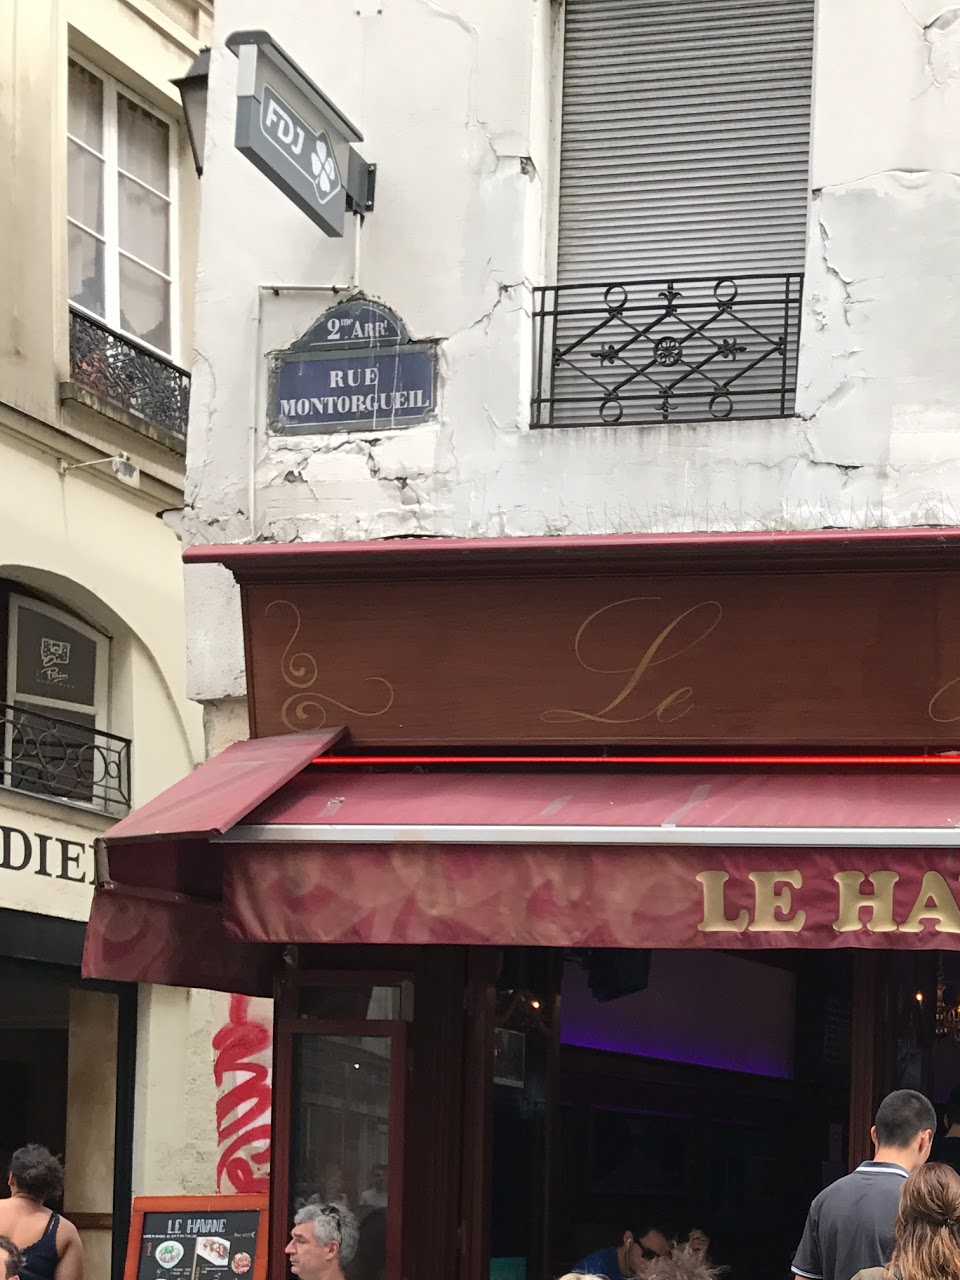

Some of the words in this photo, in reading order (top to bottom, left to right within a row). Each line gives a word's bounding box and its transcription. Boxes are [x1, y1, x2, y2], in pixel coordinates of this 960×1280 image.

[264, 98, 305, 156] FDJ
[279, 389, 430, 417] MONTORGUEIL
[329, 367, 379, 388] RUE
[538, 595, 723, 727] Le
[0, 825, 97, 885] DIE
[694, 867, 806, 934] LE
[167, 1219, 183, 1234] LE
[186, 1218, 227, 1234] HAVANE
